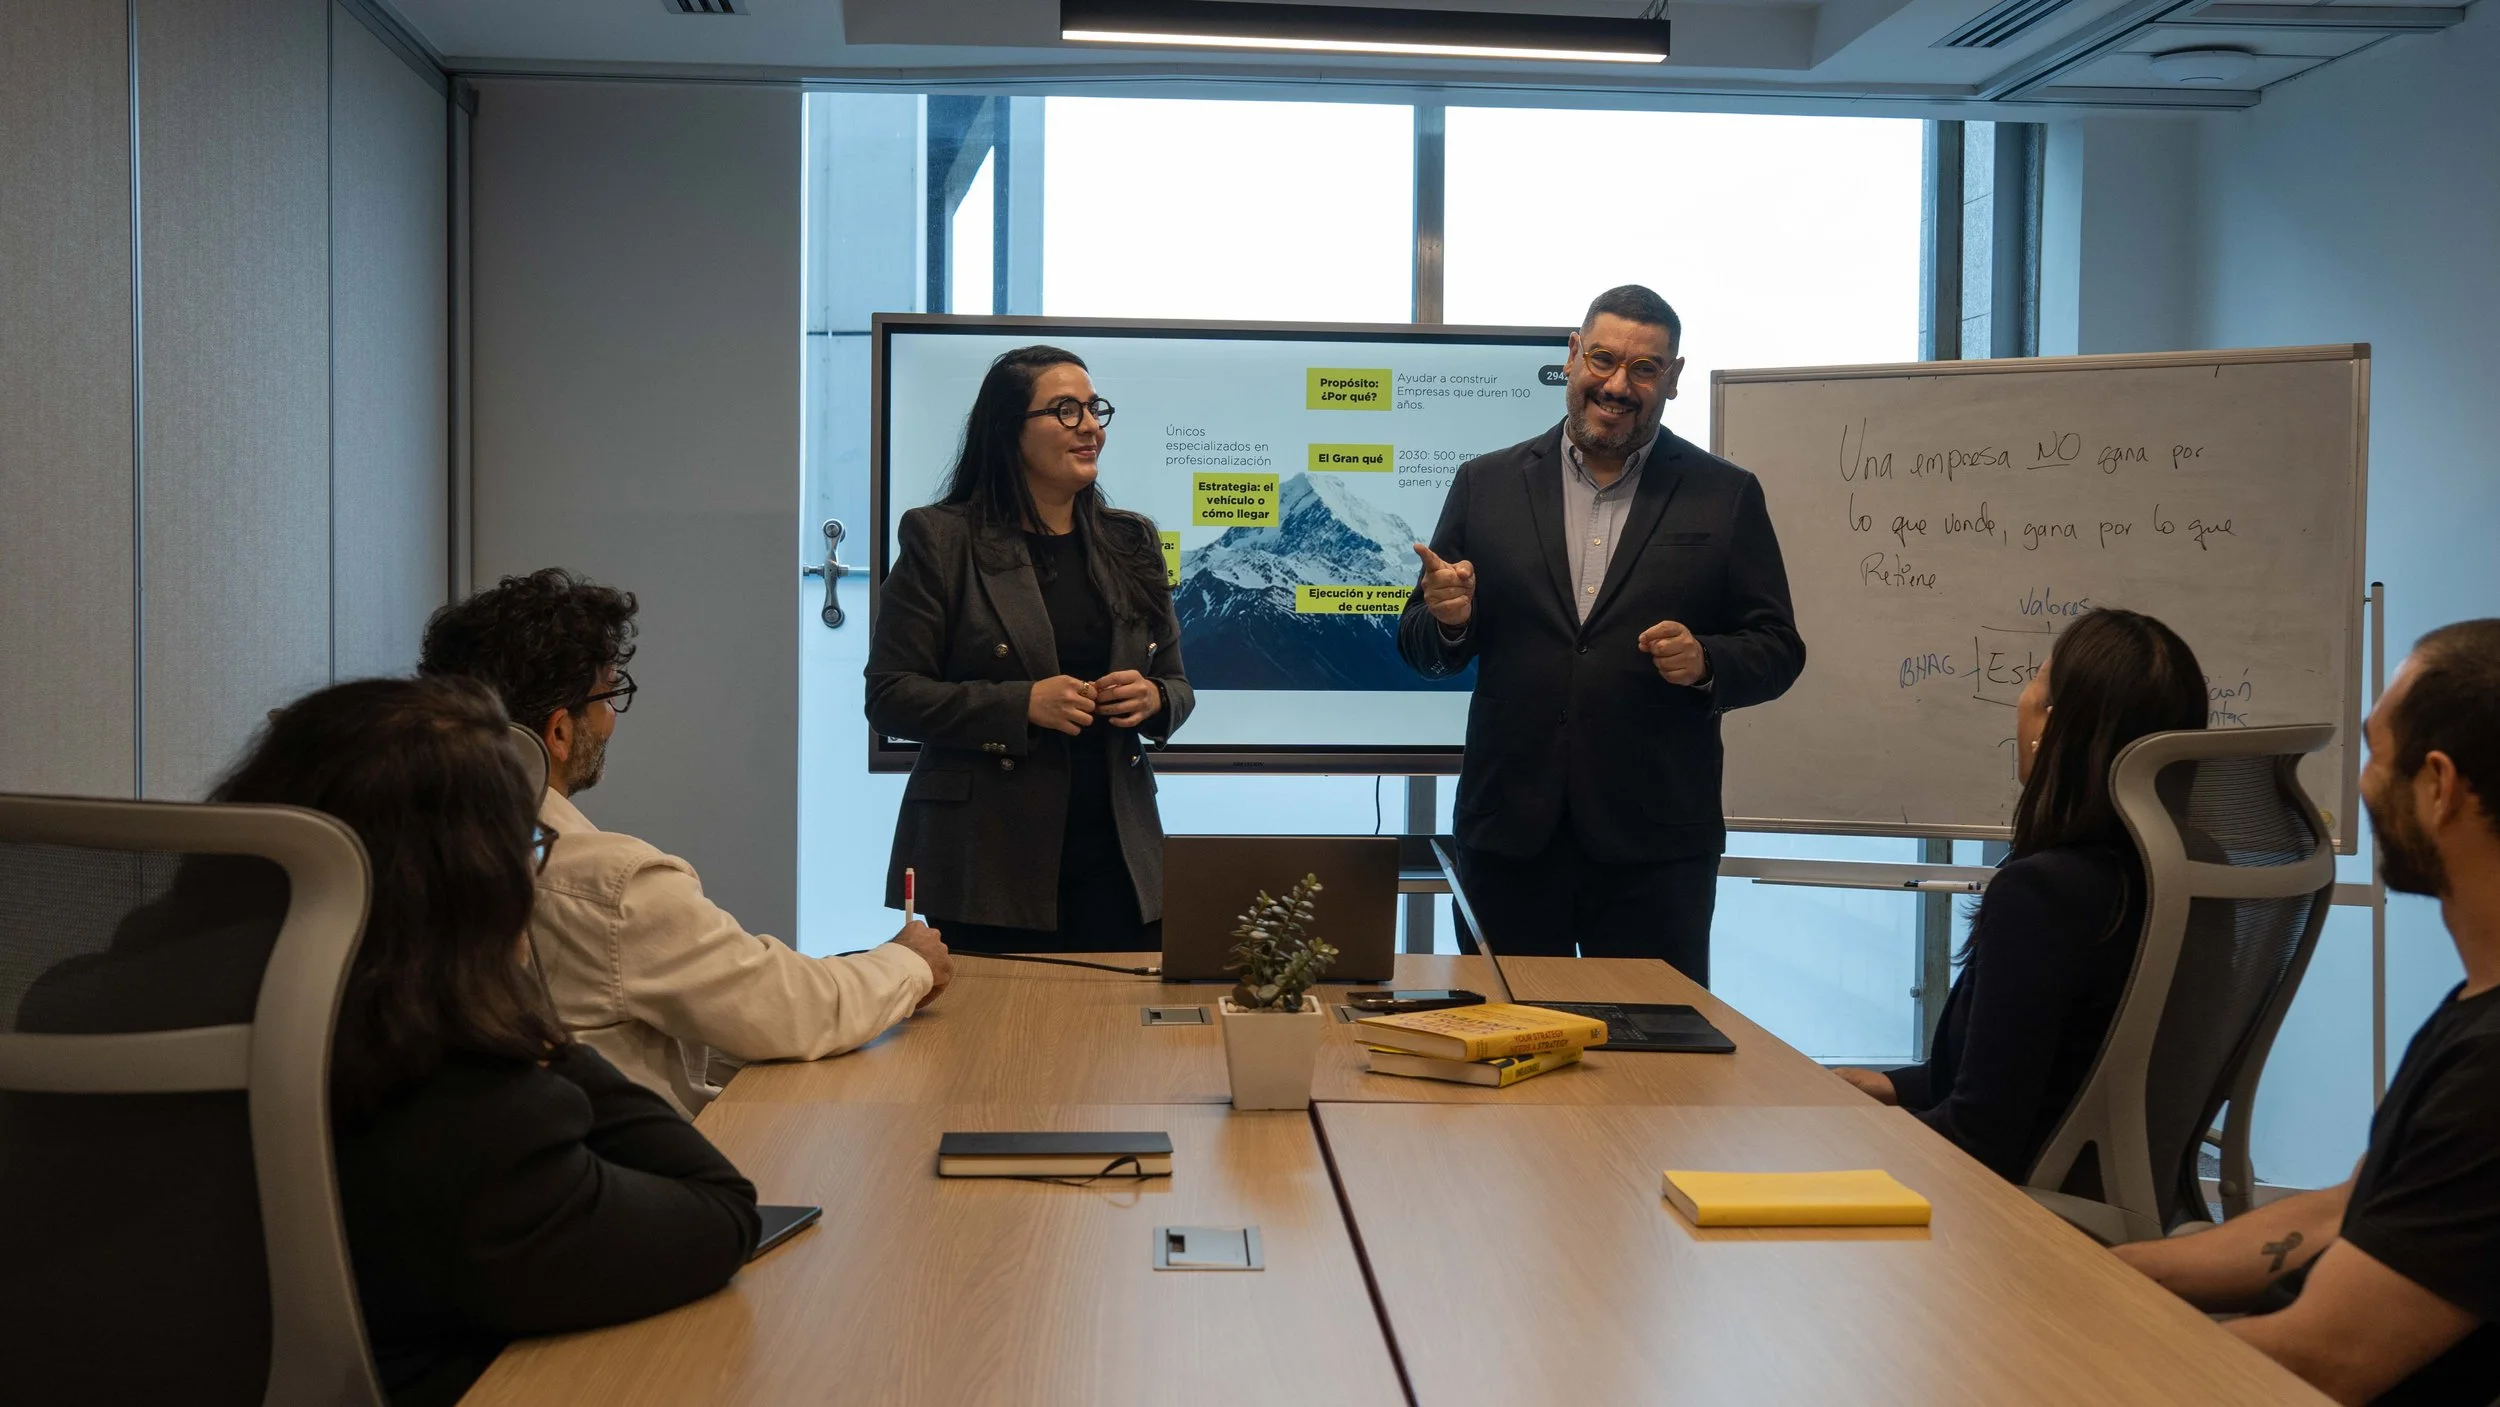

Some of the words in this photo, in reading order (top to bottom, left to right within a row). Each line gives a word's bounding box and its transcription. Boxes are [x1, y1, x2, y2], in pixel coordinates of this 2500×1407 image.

[1320, 378, 1379, 389] Propósito:
[1397, 373, 1437, 384] Ayudar
[1449, 375, 1498, 384] construir
[1321, 392, 1347, 401] ¿Por
[1350, 392, 1377, 403] qué?
[1397, 387, 1450, 398] Empresas
[1453, 389, 1474, 398] que
[1476, 388, 1508, 398] duren
[1511, 388, 1531, 398] 100
[1396, 400, 1425, 410] años.
[1166, 424, 1206, 437] Únicos
[1165, 441, 1251, 452] especializados
[1254, 443, 1269, 452] en
[1840, 417, 1892, 482] Una
[1910, 446, 2011, 482] empresa
[2037, 430, 2081, 461] NO
[2097, 446, 2149, 474] gana
[2172, 444, 2204, 470] por
[1165, 455, 1272, 466] profesionalización
[1318, 453, 1329, 463] El
[1332, 454, 1359, 464] Gran
[1362, 454, 1383, 465] qué
[1399, 450, 1430, 460] 2030:
[1433, 450, 1456, 461] 500
[1198, 482, 1260, 493] Estrategia:
[1263, 482, 1274, 492] el
[1398, 479, 1432, 488] ganen
[1435, 480, 1442, 488] y
[1206, 496, 1255, 505] vehículo
[1202, 508, 1234, 519] cómo
[1237, 509, 1270, 520] llegar
[1891, 516, 1927, 548] que
[2023, 522, 2077, 551] gana
[2099, 521, 2132, 549] por
[2187, 518, 2237, 551] que
[1309, 589, 1363, 599] Ejecución
[1367, 591, 1374, 600] y
[1376, 589, 1413, 599] rendic
[1338, 602, 1352, 611] de
[1356, 603, 1400, 612] cuentas
[1900, 653, 1956, 689] BHAG
[1513, 1032, 1533, 1042] YOUR
[1533, 1030, 1564, 1040] STRATEGY
[1537, 1039, 1569, 1051] STRATEGY
